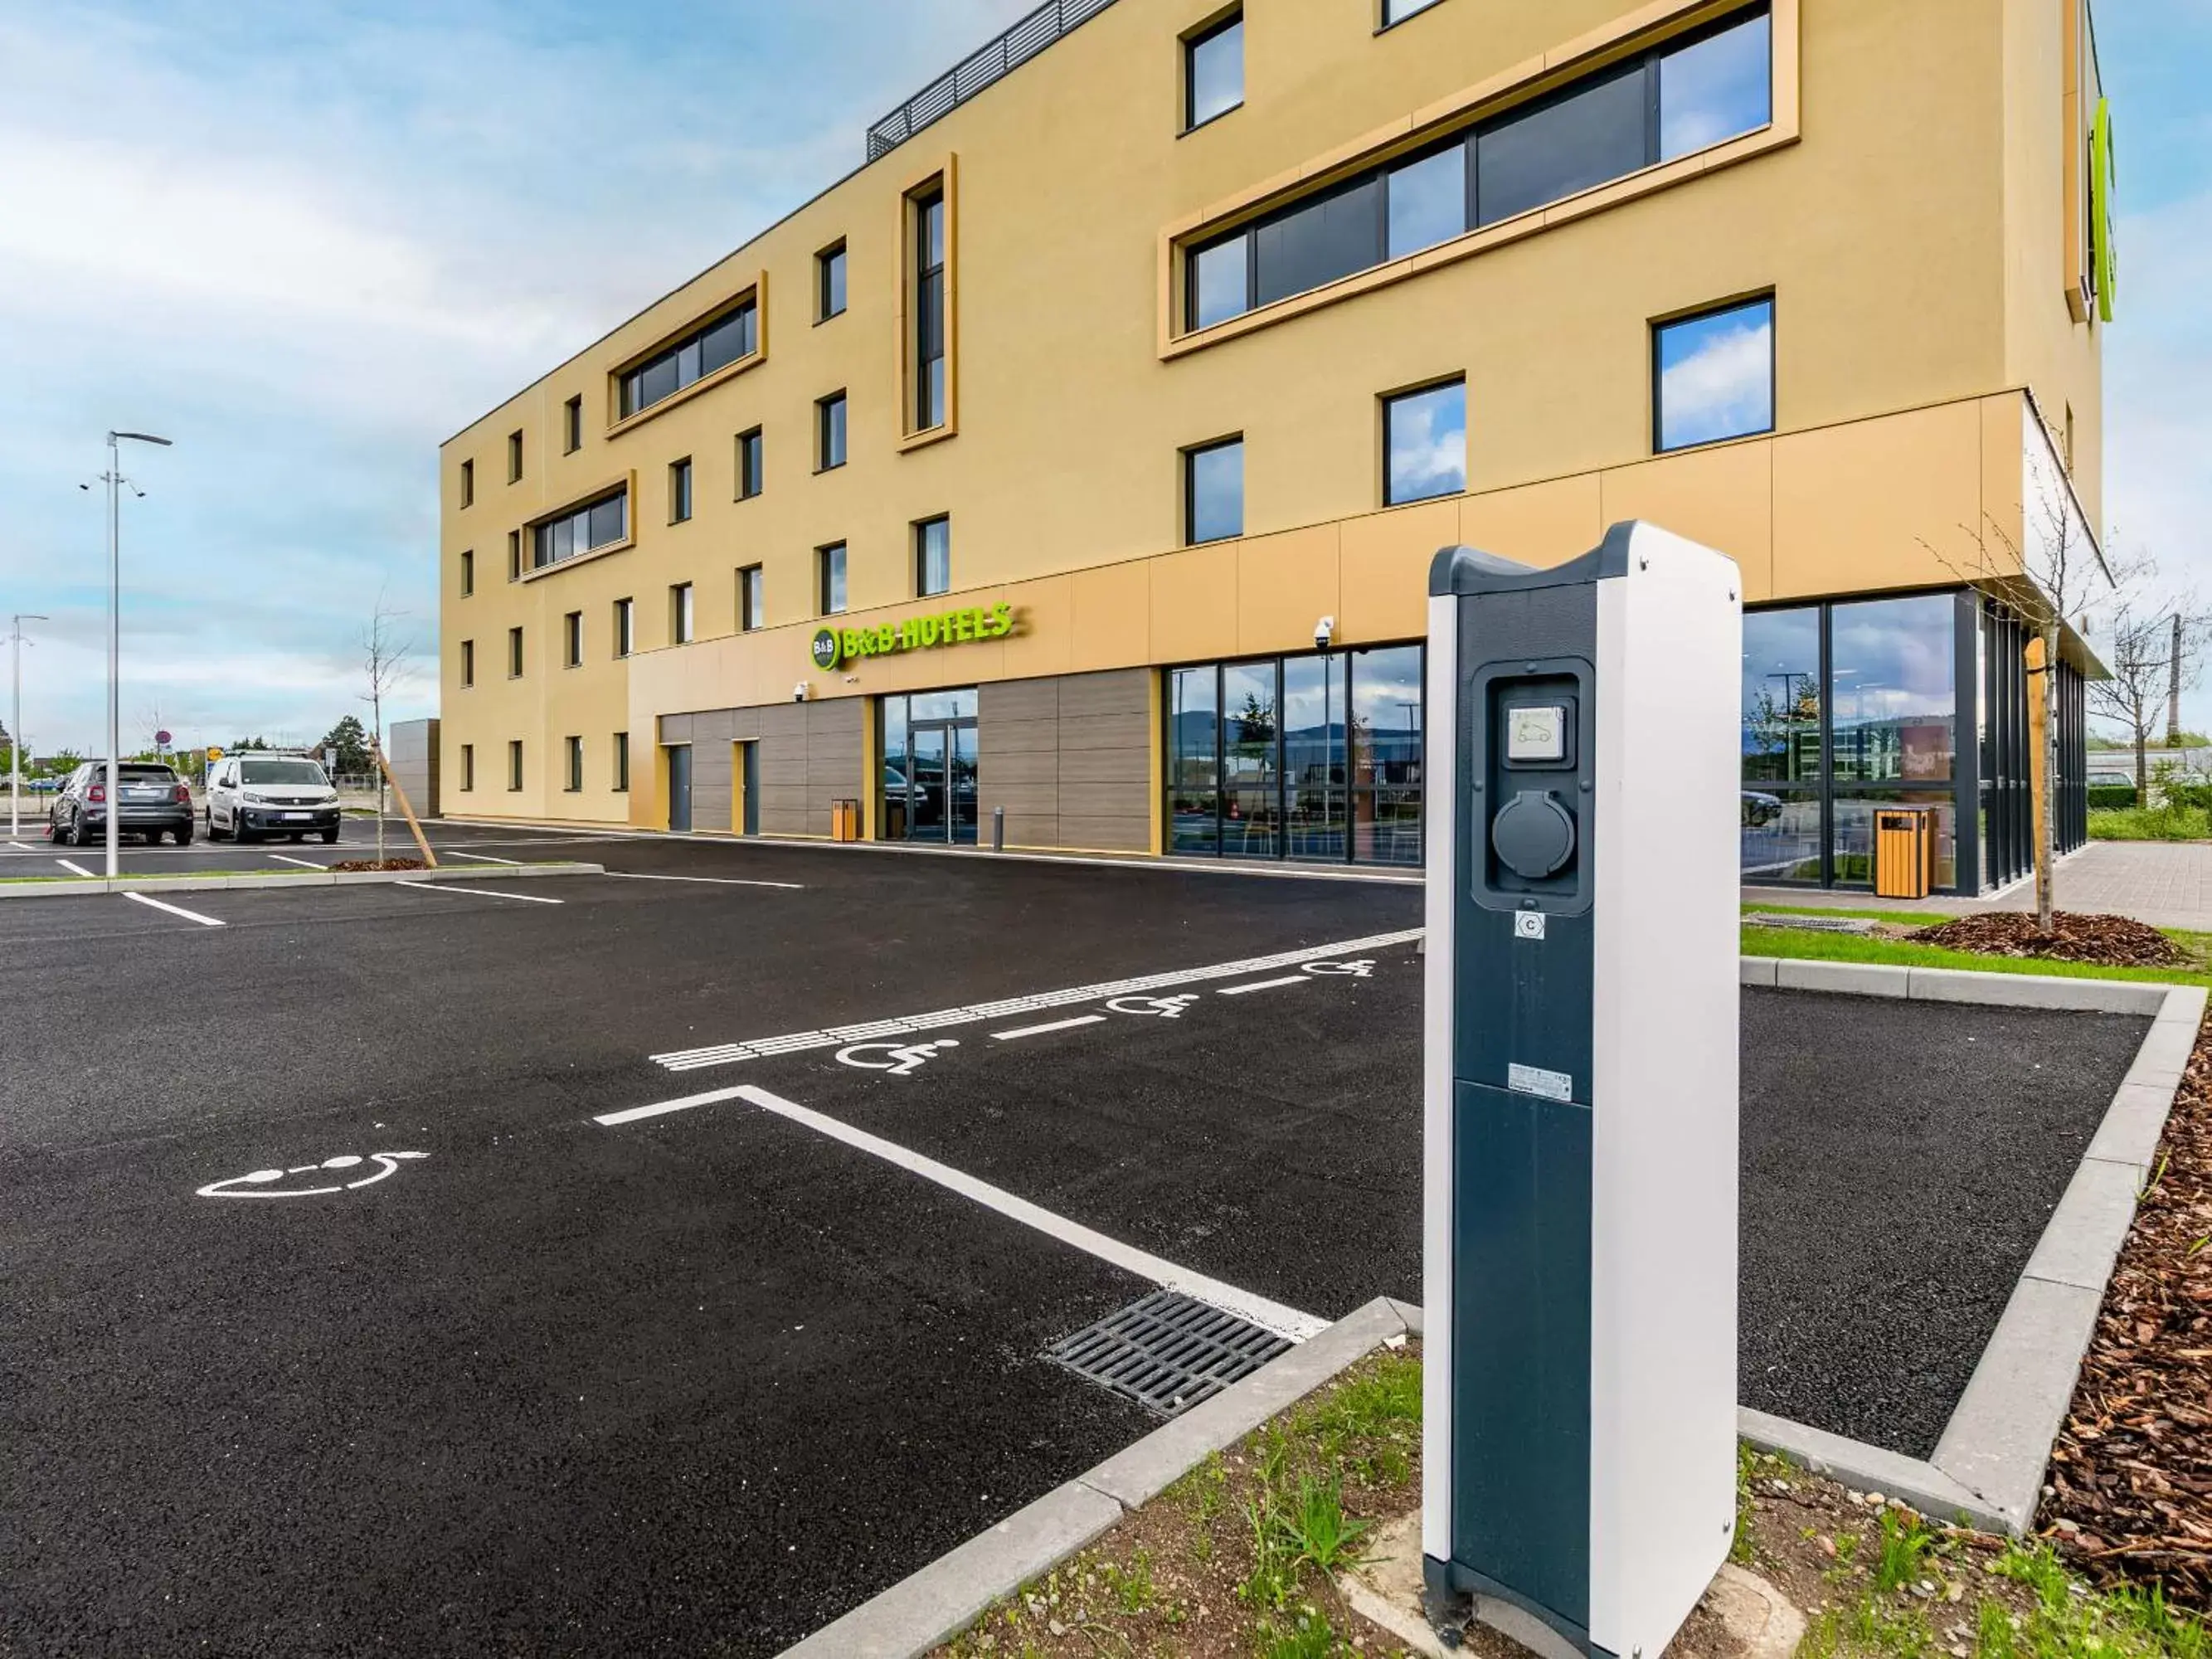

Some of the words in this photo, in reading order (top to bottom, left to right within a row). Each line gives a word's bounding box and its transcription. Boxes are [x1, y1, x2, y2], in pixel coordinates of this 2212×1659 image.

[843, 623, 895, 659] B&B
[902, 601, 1013, 649] HOTELS
[814, 639, 834, 654] B&B
[1526, 919, 1534, 930] C
